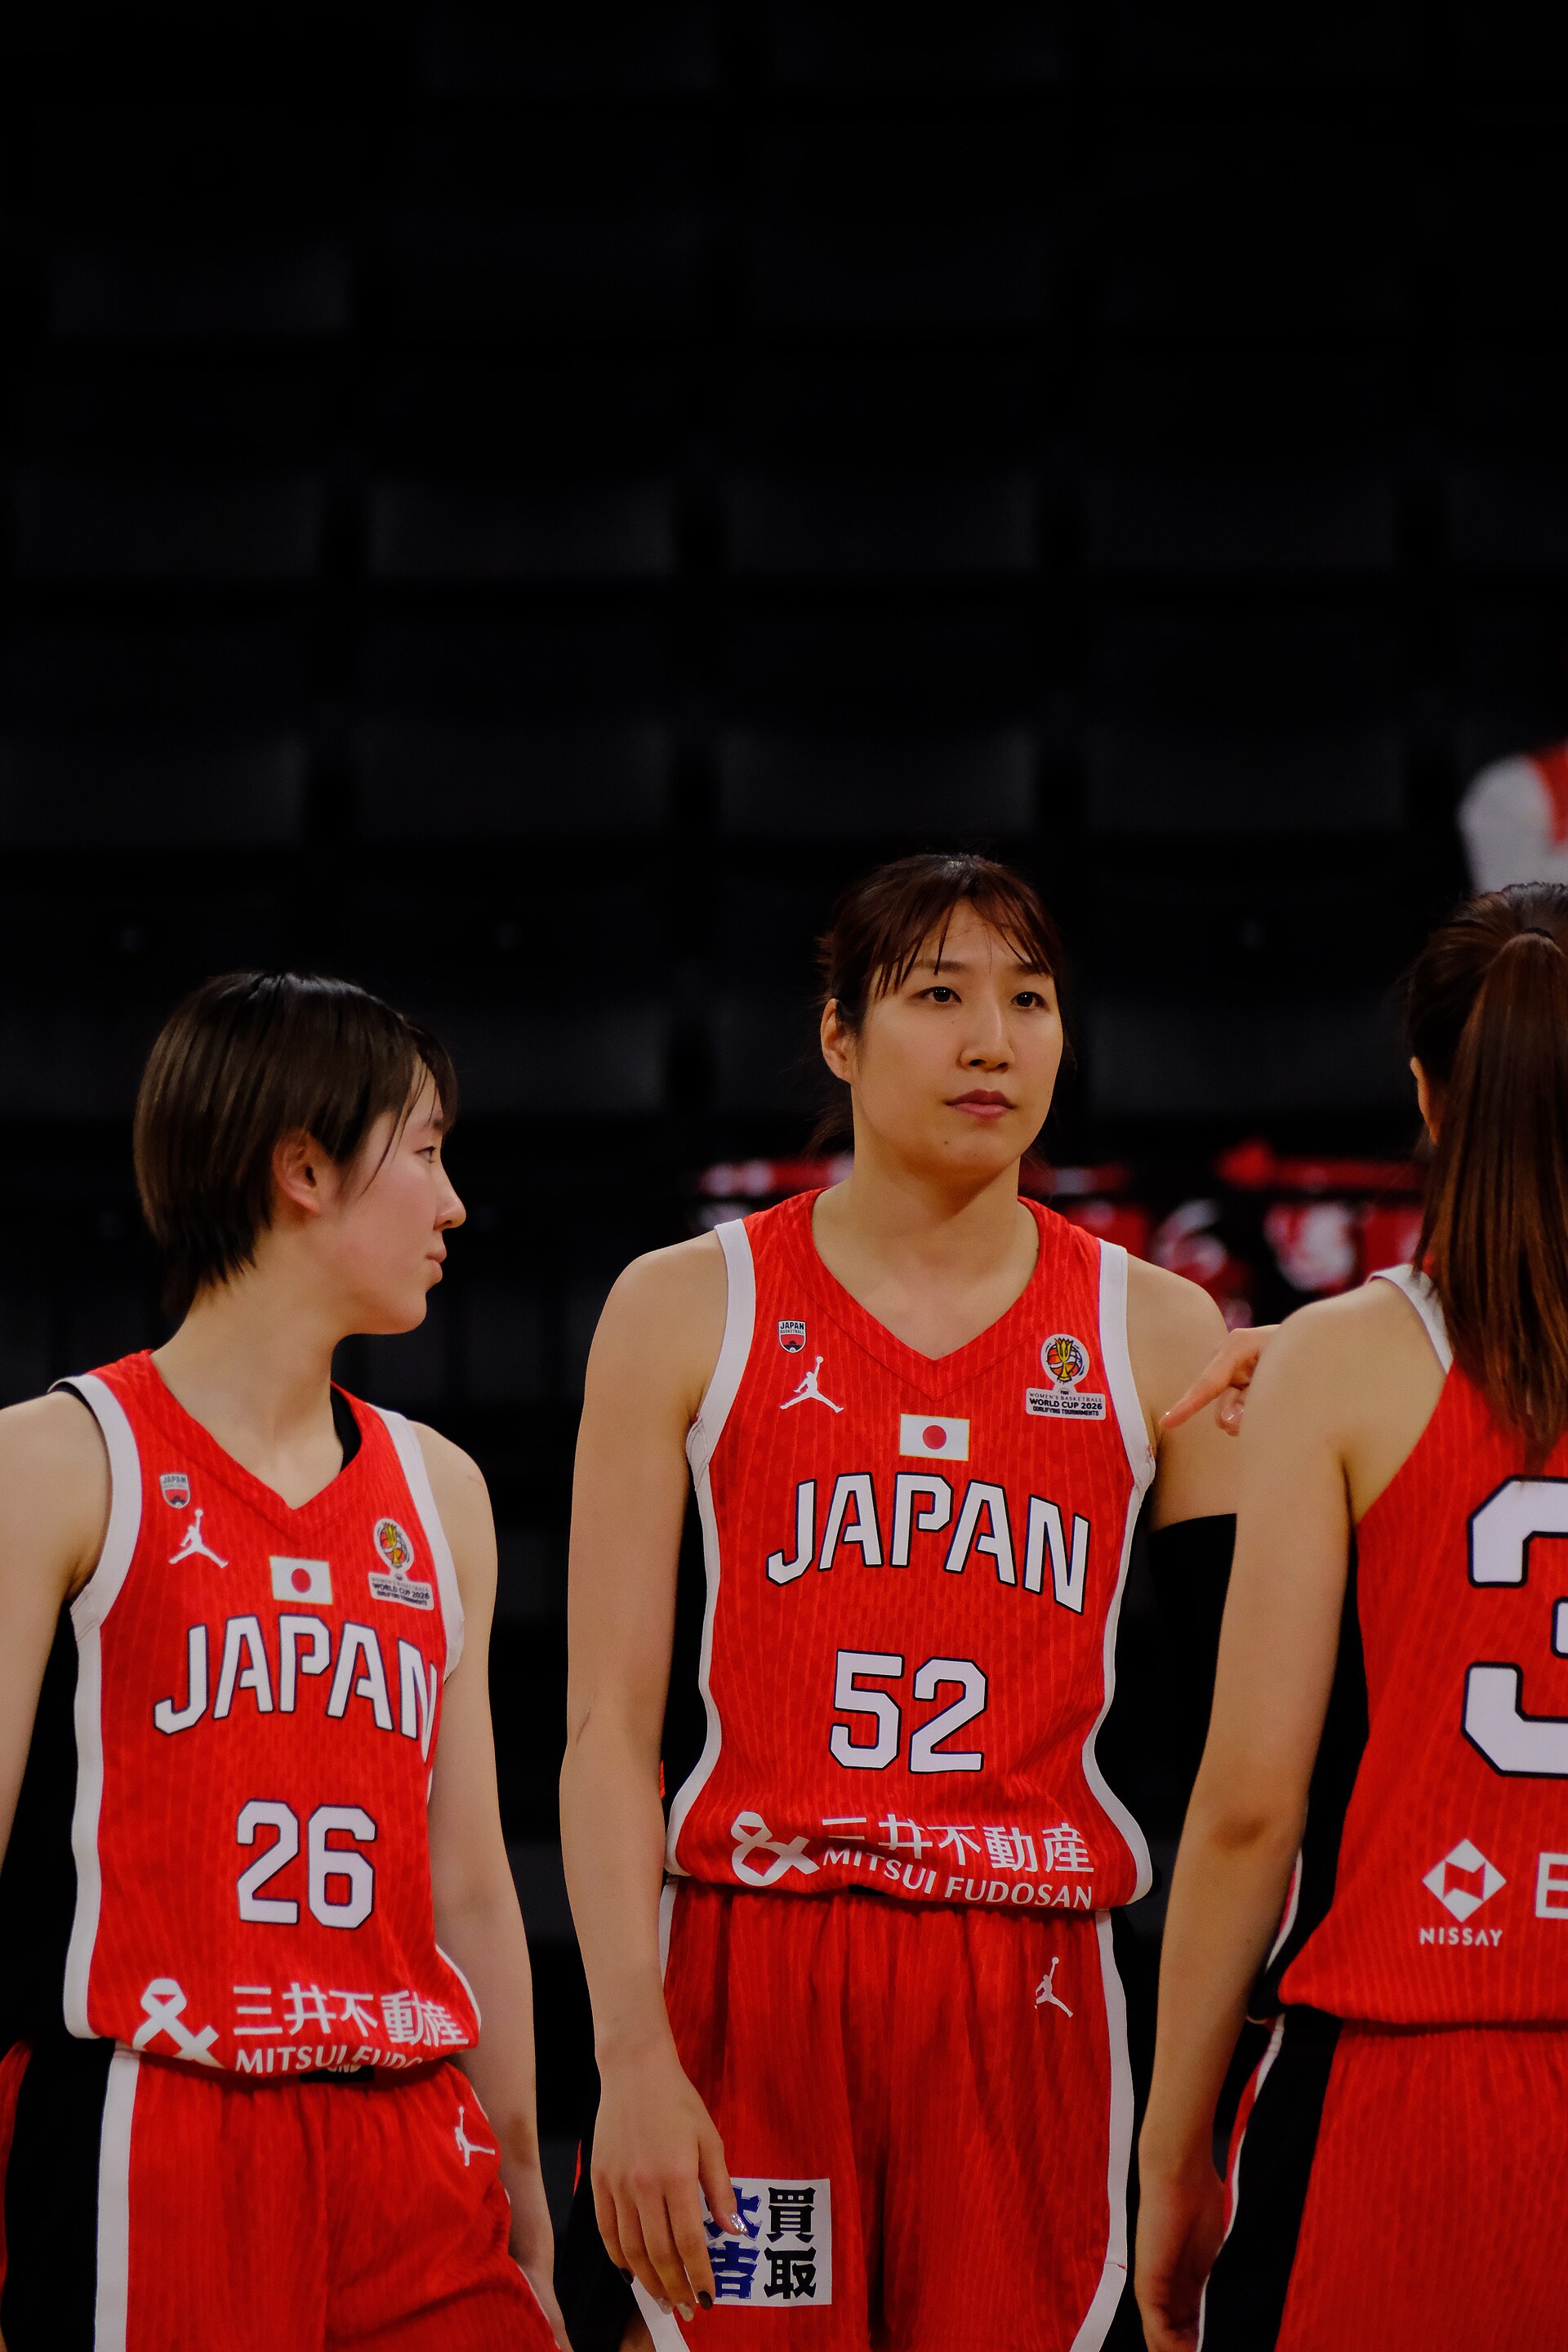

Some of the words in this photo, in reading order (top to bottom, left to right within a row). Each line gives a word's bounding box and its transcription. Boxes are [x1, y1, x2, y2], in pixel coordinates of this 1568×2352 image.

[780, 1321, 804, 1330] JAPAN
[1029, 1392, 1059, 1401] WOMEN'S
[1029, 1397, 1060, 1408] WORLD
[1081, 1402, 1102, 1410] 2026
[766, 1472, 1090, 1615] JAPAN
[153, 1613, 438, 1764] JAPAN
[829, 1648, 987, 1773] 52
[235, 1797, 377, 1929] 26
[822, 1846, 938, 1895] MITSUI
[944, 1876, 1092, 1910] FUDOSAN
[1419, 1927, 1503, 1948] NISSAY
[233, 1981, 470, 2047] 三井不動産
[235, 2044, 348, 2074] MITSUI
[764, 2186, 817, 2300] 買取
